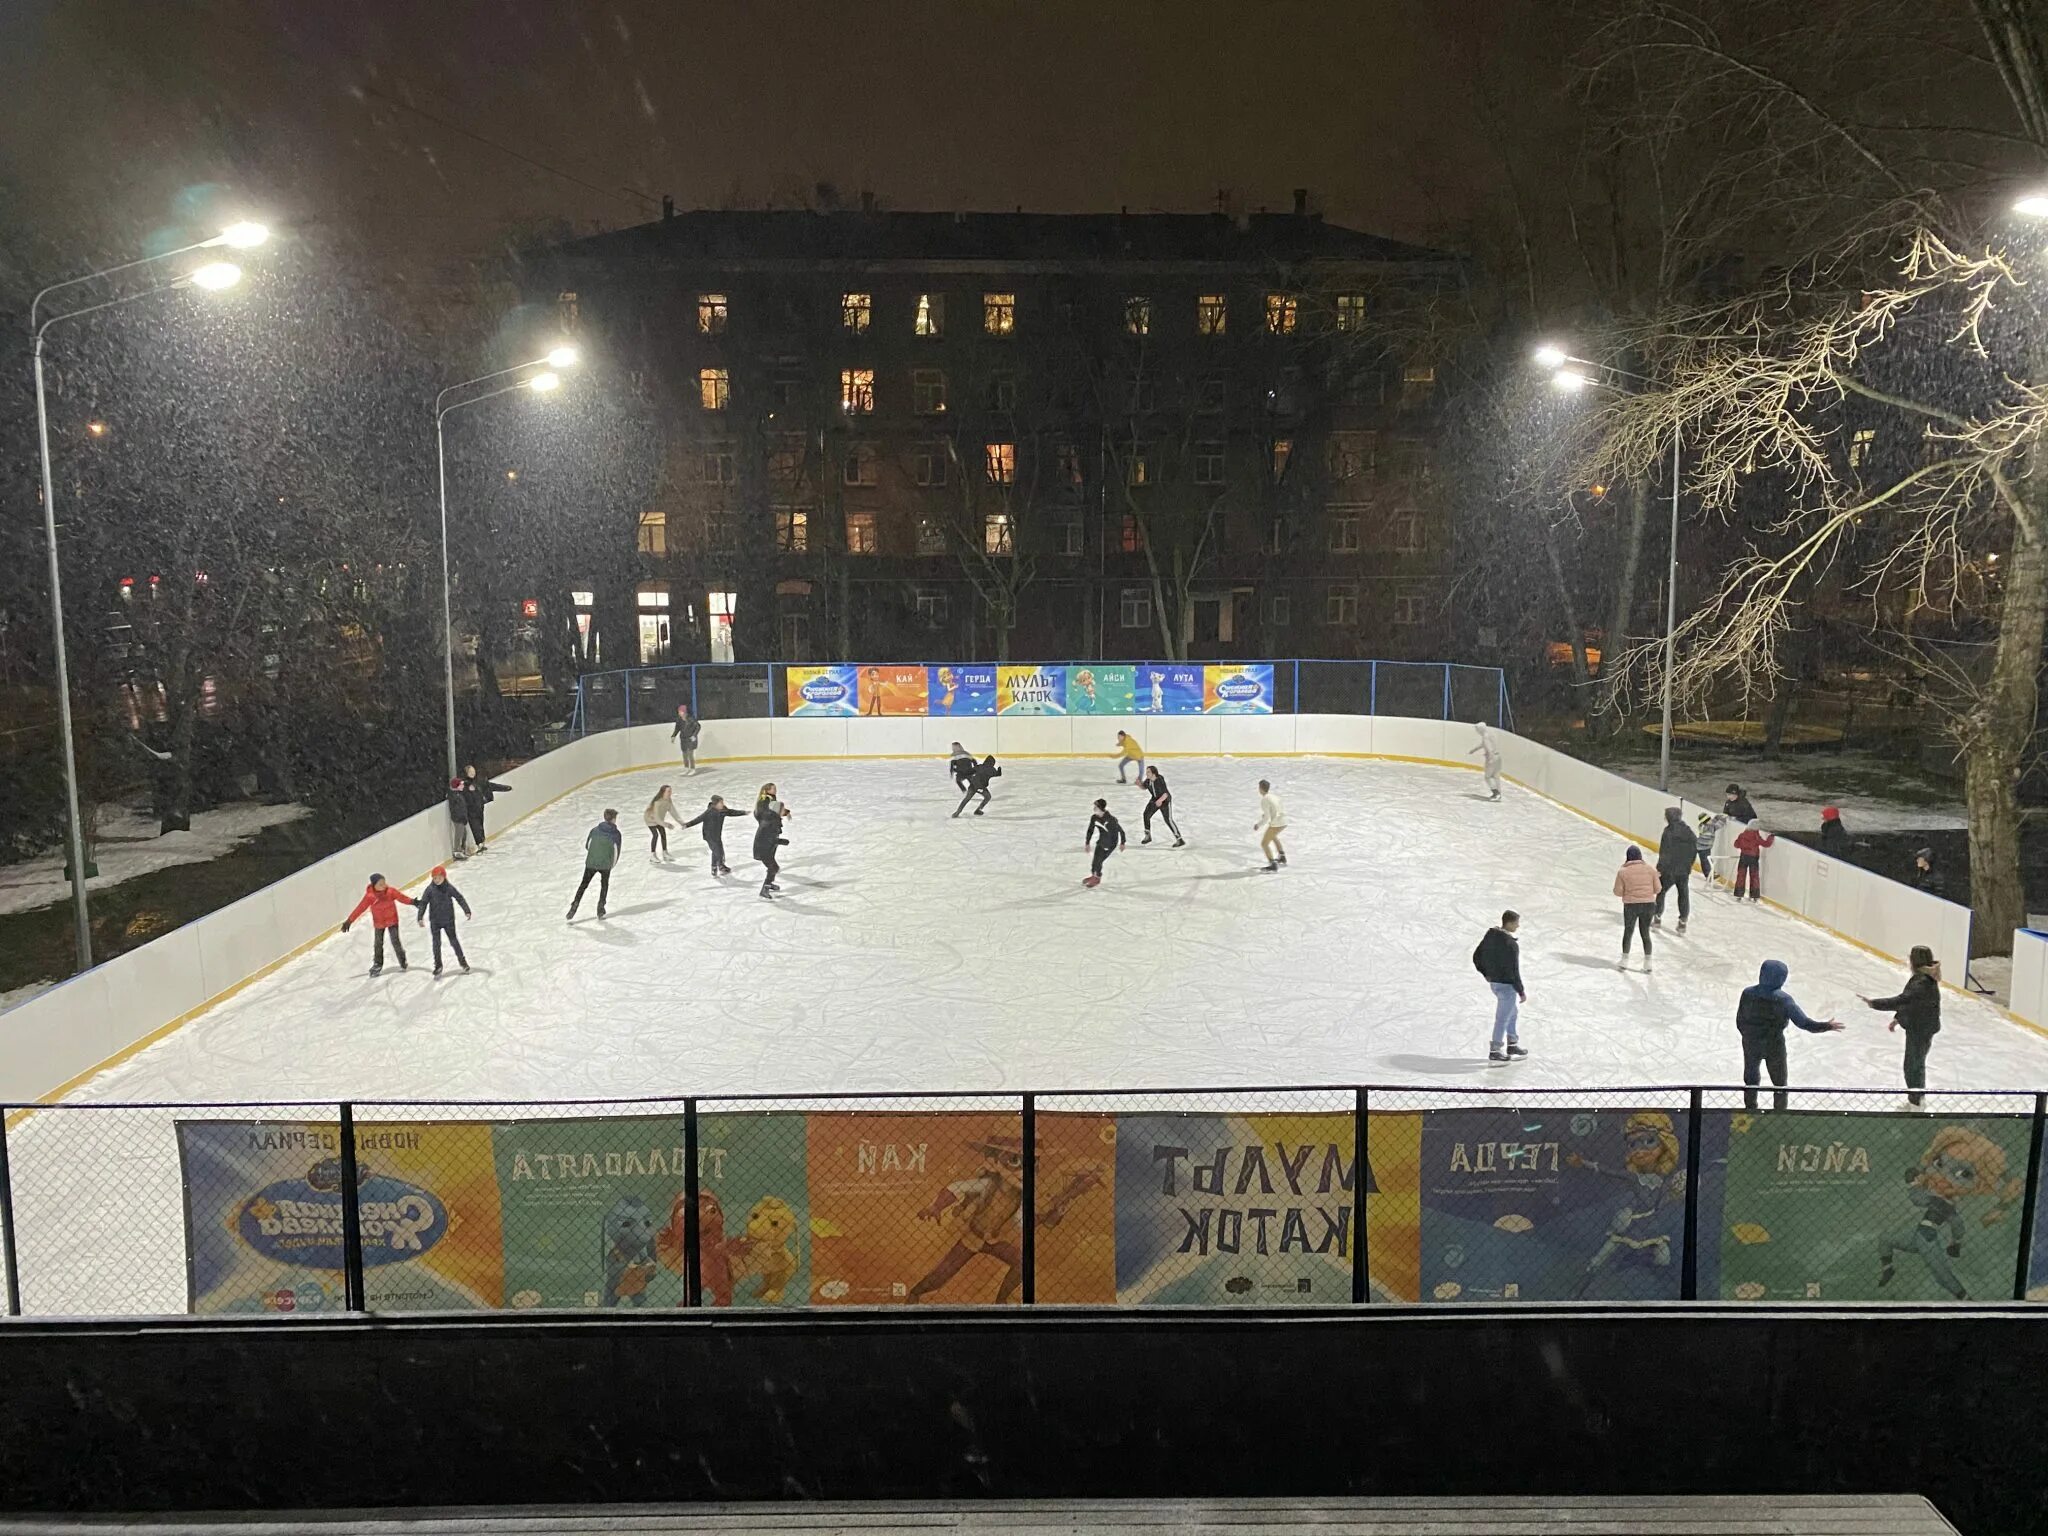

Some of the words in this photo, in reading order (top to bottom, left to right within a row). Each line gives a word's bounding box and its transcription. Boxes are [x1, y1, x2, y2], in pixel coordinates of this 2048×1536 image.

[896, 674, 913, 683] КАЙ
[964, 674, 991, 683] ГЕРДА
[1005, 674, 1058, 689] МУЛЬТ
[1103, 672, 1125, 682] АЙСИ
[1173, 674, 1194, 683] ЛУТА
[1012, 691, 1052, 702] КАТОК
